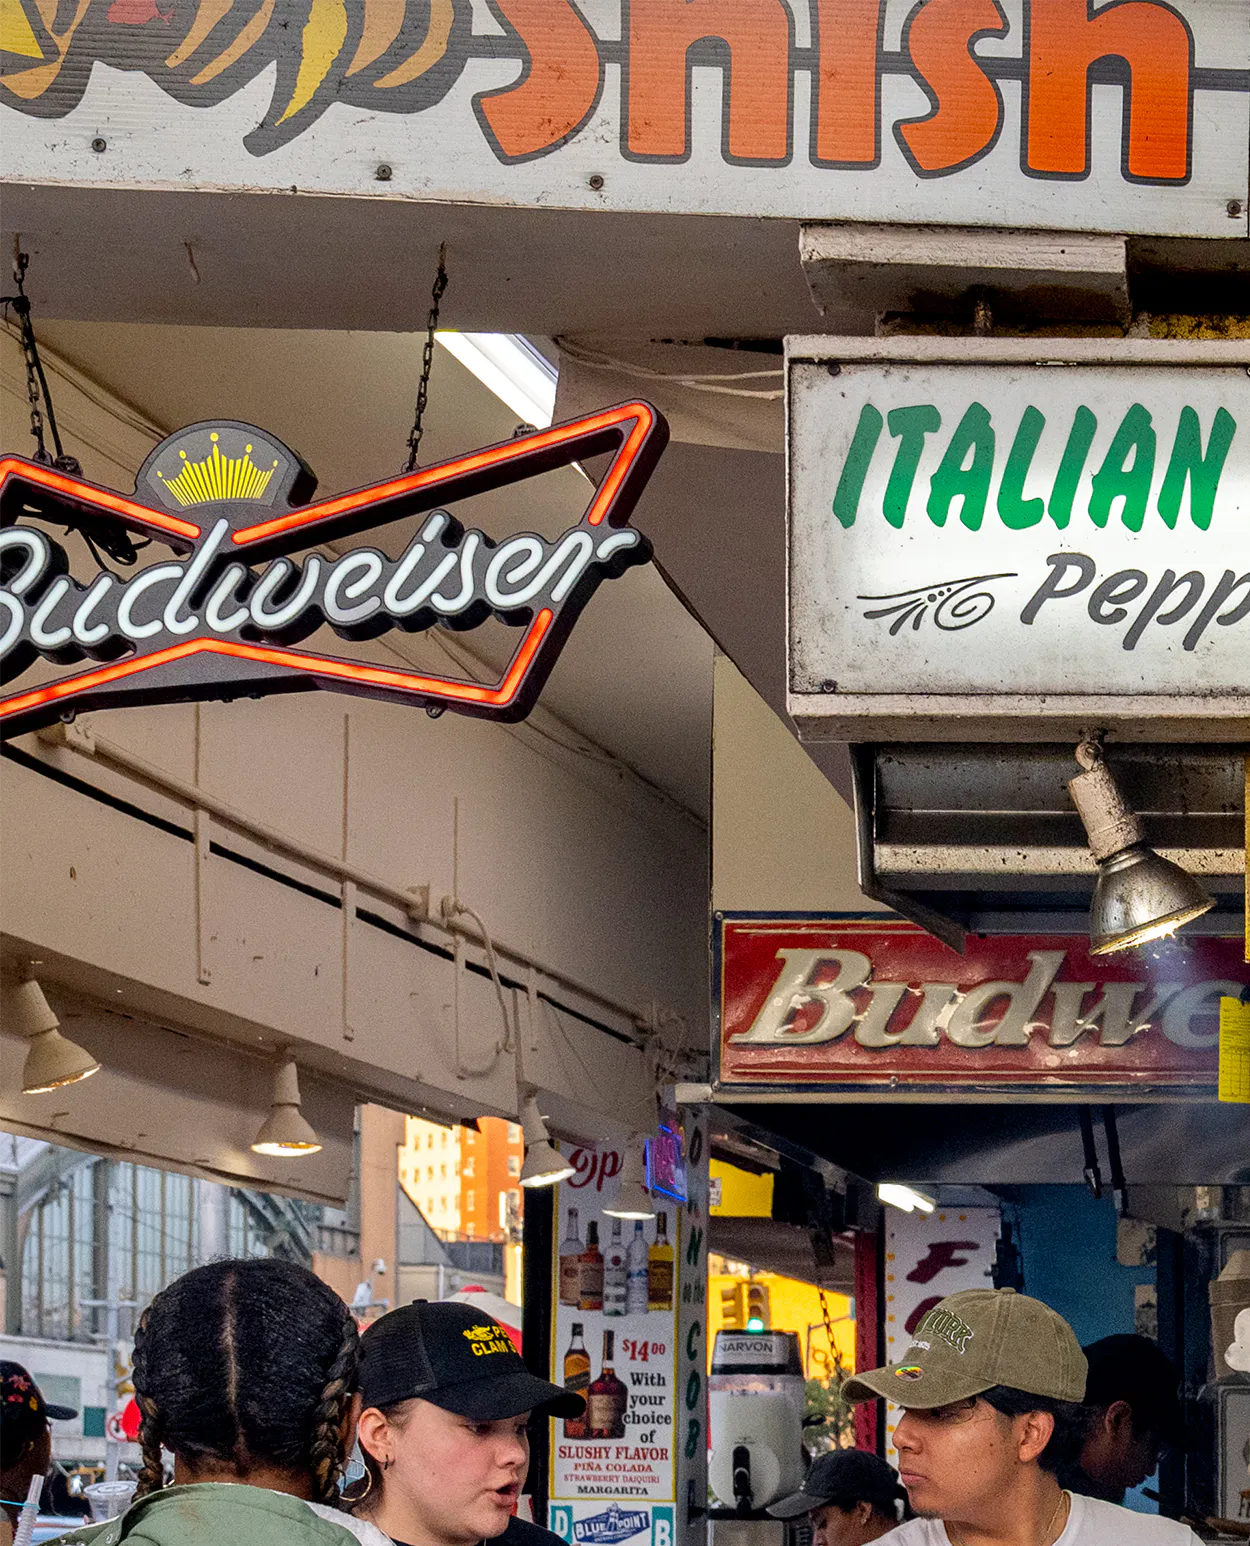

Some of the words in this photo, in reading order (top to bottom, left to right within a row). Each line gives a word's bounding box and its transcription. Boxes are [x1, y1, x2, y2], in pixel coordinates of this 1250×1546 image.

[832, 402, 1236, 532] ITALIAN
[0, 510, 642, 662] Budweiser
[471, 1340, 509, 1356] CLAM
[720, 1341, 773, 1353] NARVON
[630, 1372, 666, 1387] With
[629, 1395, 666, 1410] your
[623, 1411, 671, 1425] choice
[640, 1430, 656, 1444] of
[559, 1446, 611, 1460] SLUSHY
[615, 1446, 669, 1461] FLAVOR
[605, 1463, 653, 1473] COLADA
[564, 1475, 620, 1484] STRAWBERRY
[578, 1486, 649, 1496] MARGARITA
[575, 1523, 606, 1540] BLUE
[618, 1513, 647, 1529] POINT
